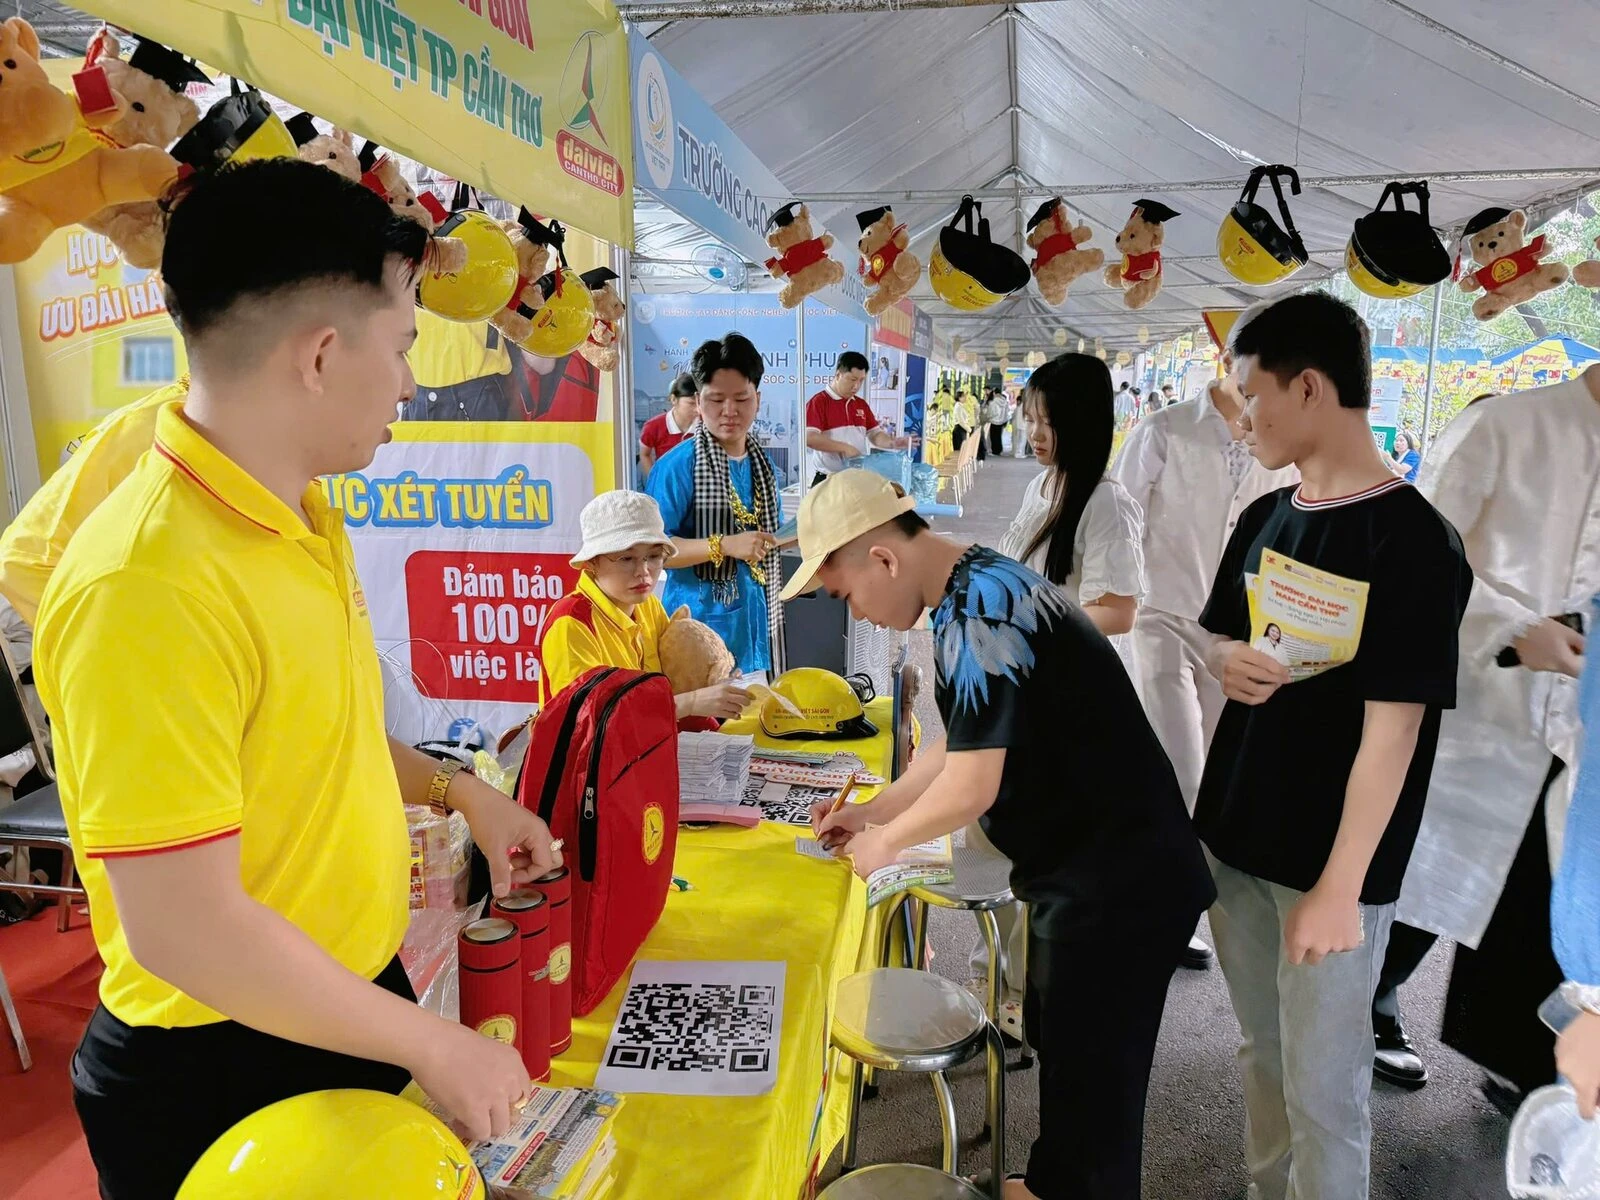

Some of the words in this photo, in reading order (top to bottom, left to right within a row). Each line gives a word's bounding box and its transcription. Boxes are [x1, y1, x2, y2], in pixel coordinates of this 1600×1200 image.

[422, 27, 459, 101] TP
[462, 43, 506, 132] CẦN
[510, 81, 543, 149] THƠ
[601, 179, 619, 193] CITY
[678, 125, 742, 220] TRƯỜNG
[744, 187, 768, 240] CAO
[80, 284, 126, 331] ĐÃI
[377, 476, 436, 519] XÉT
[445, 470, 549, 521] TUYỂN
[443, 563, 505, 597] Đảm
[512, 565, 564, 600] bảo
[451, 602, 547, 646] 100%
[449, 649, 507, 686] việc
